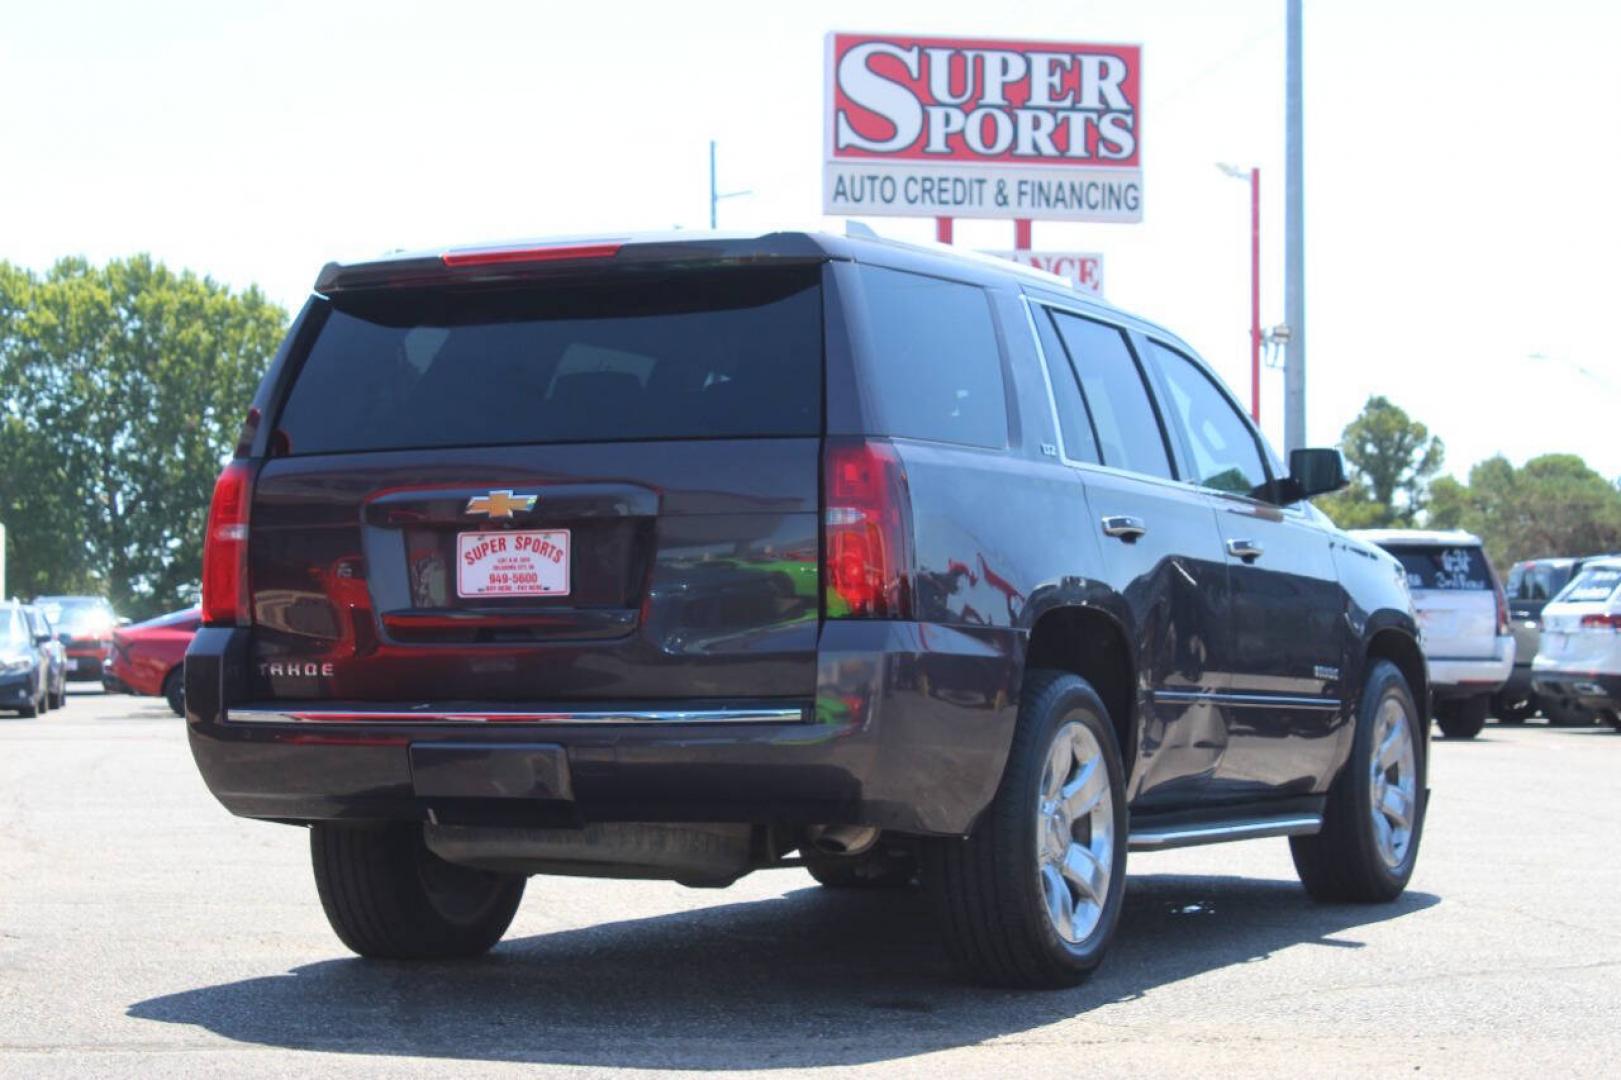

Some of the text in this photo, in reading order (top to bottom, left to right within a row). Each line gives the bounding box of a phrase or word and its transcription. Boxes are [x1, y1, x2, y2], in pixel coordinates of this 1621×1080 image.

[837, 42, 1133, 112] SUPER
[832, 175, 1140, 211] AUTO CREDIT & FINANCING
[464, 534, 564, 565] SUPER SPORTS
[257, 662, 335, 677] TAHOE
